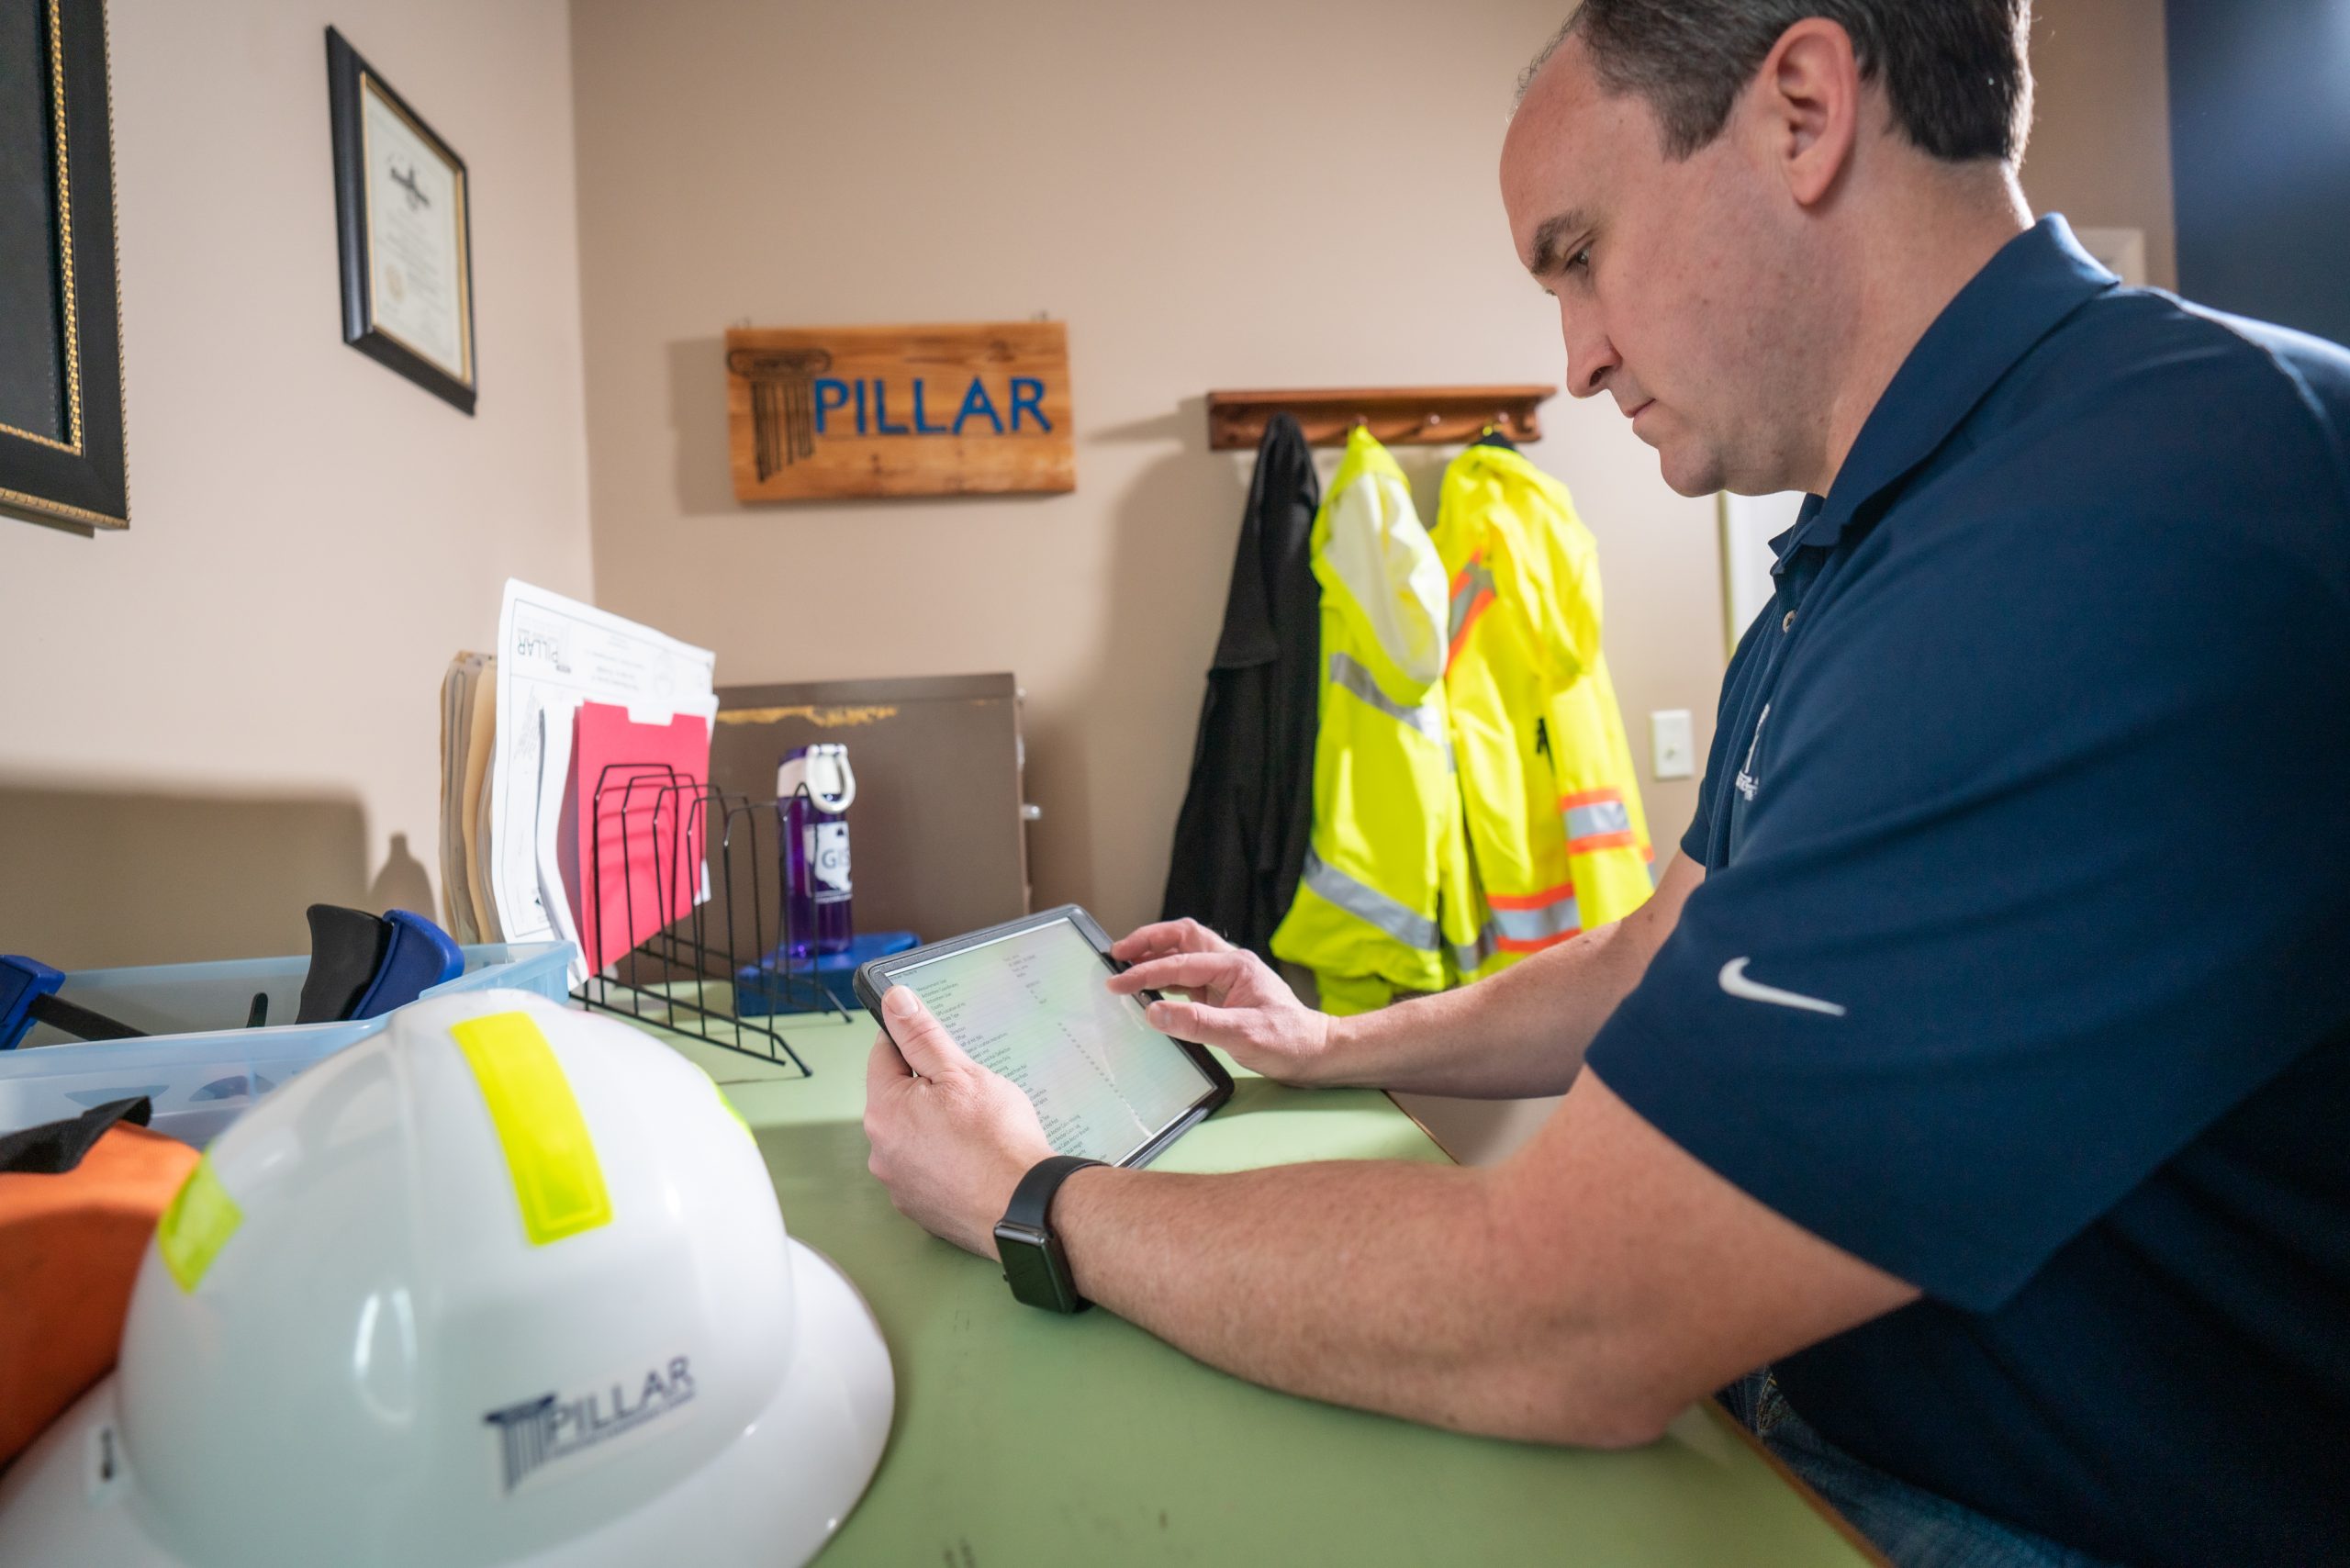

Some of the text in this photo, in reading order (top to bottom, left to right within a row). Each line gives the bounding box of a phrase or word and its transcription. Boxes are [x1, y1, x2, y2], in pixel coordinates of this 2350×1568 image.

[813, 376, 1053, 435] PILLAR
[518, 634, 558, 664] PILLAR
[548, 1356, 696, 1444] PILLAR
